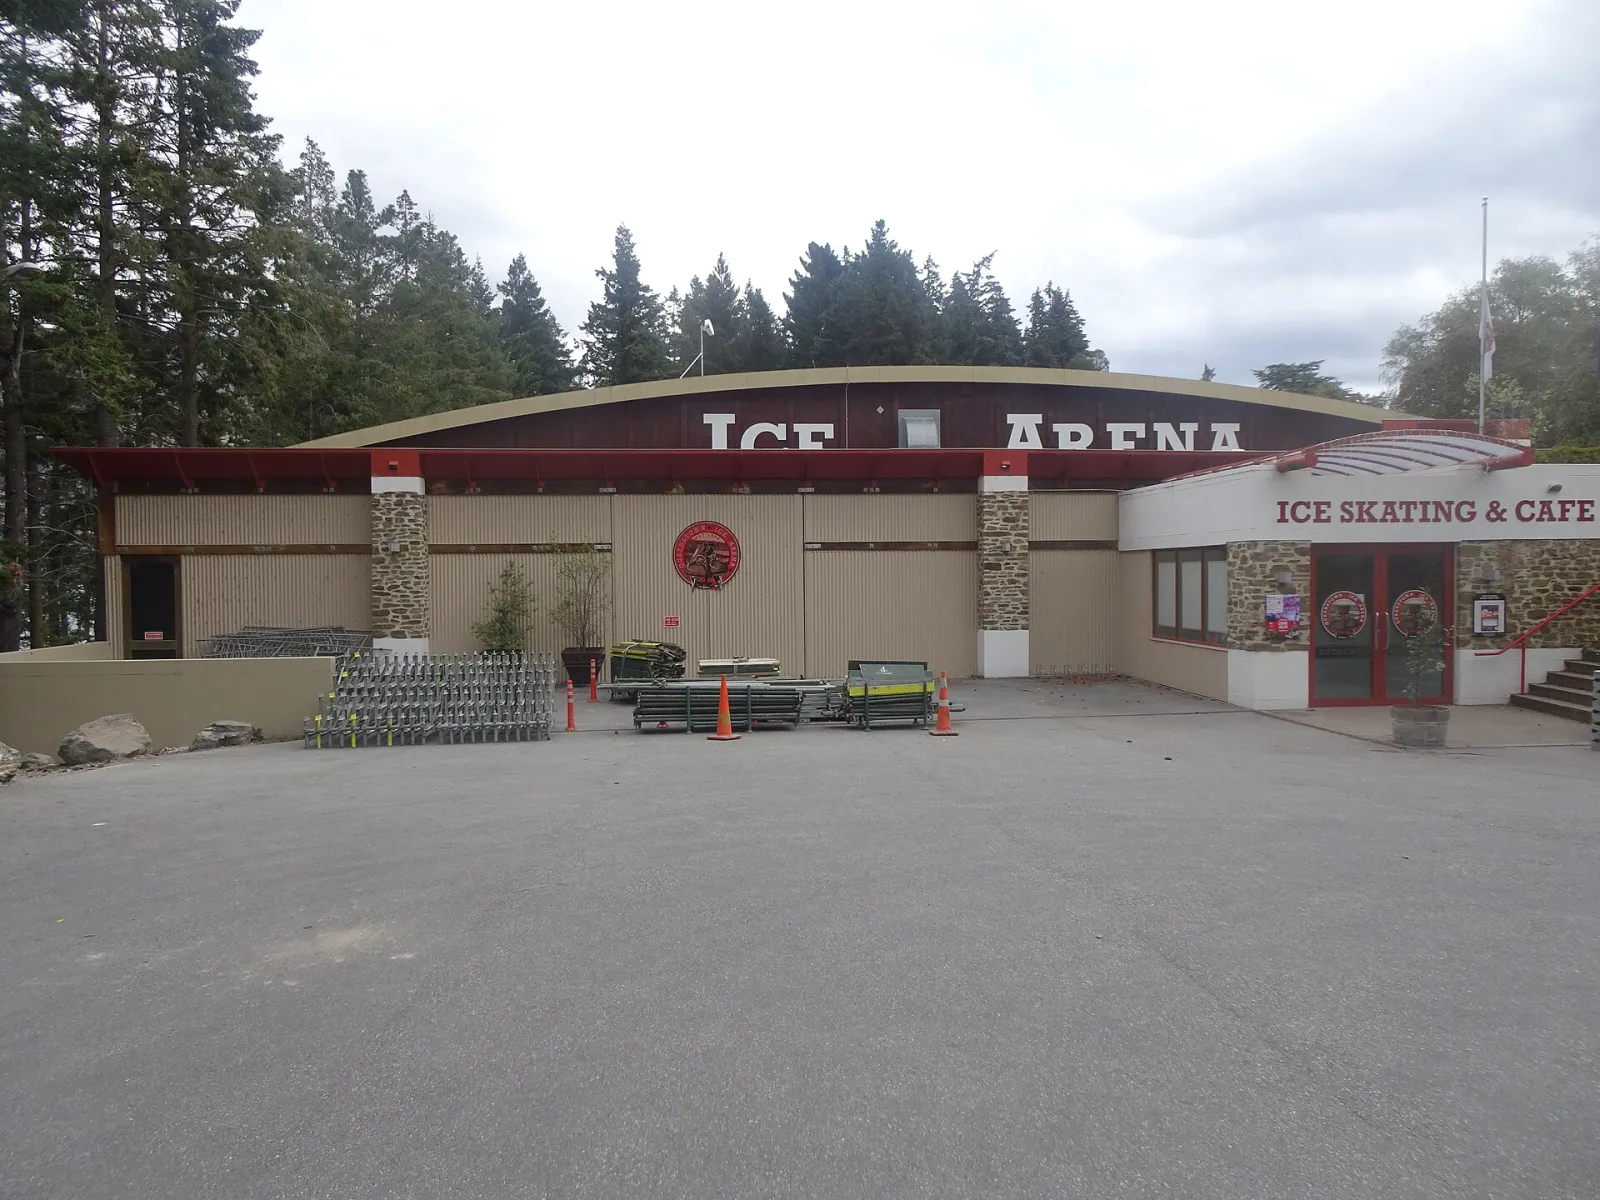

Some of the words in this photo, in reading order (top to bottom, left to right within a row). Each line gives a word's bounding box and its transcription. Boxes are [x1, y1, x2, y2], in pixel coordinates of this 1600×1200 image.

[1276, 501, 1332, 523] ICE
[1339, 501, 1478, 523] SKATING
[1485, 500, 1507, 522] &
[1514, 500, 1595, 522] CAFE
